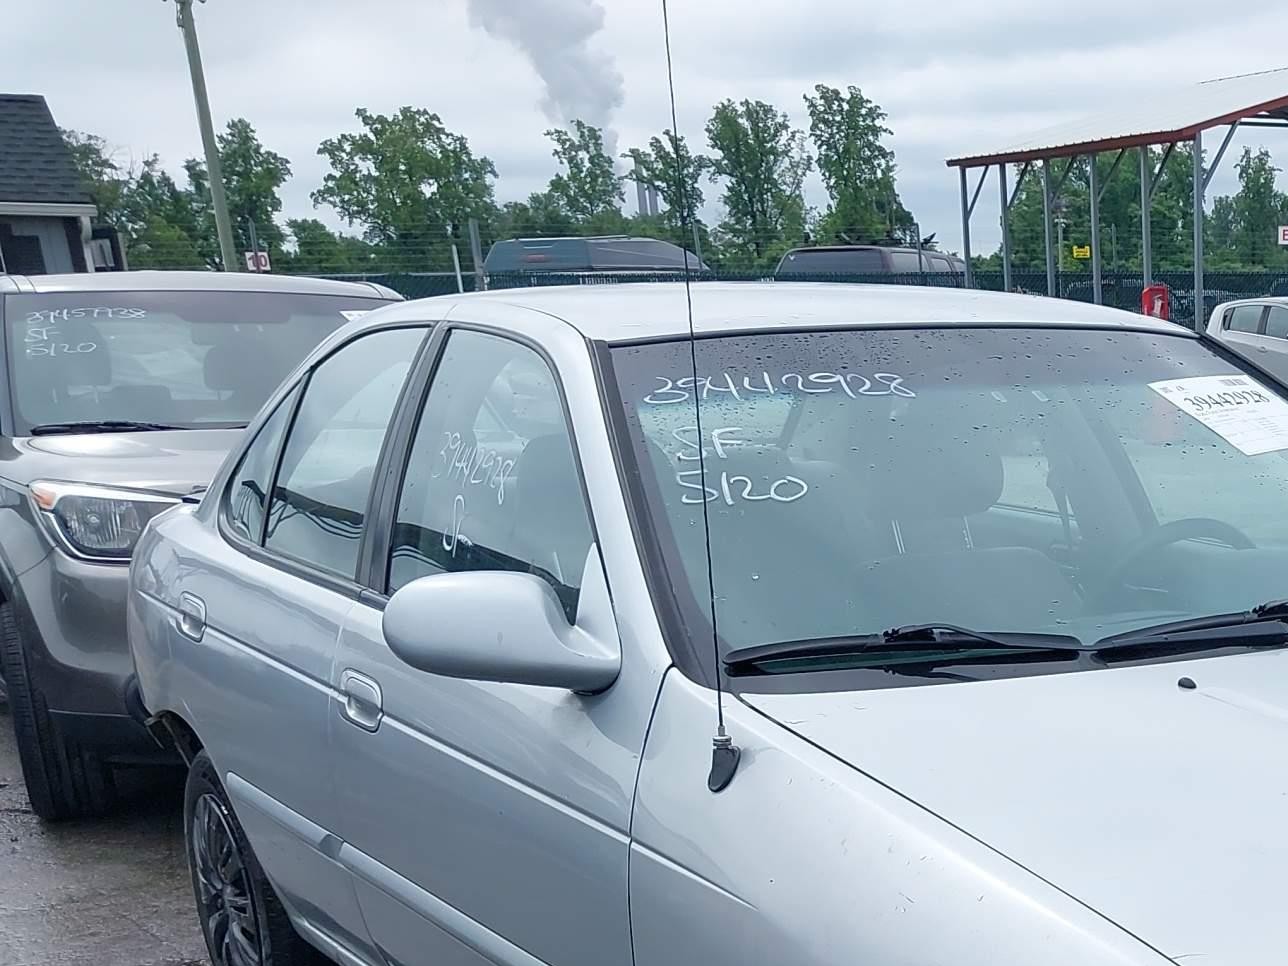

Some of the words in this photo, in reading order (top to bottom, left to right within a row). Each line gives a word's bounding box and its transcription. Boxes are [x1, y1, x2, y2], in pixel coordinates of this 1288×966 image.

[643, 371, 917, 404] 39442928
[1184, 390, 1270, 411] 39442928
[672, 426, 744, 461] SF
